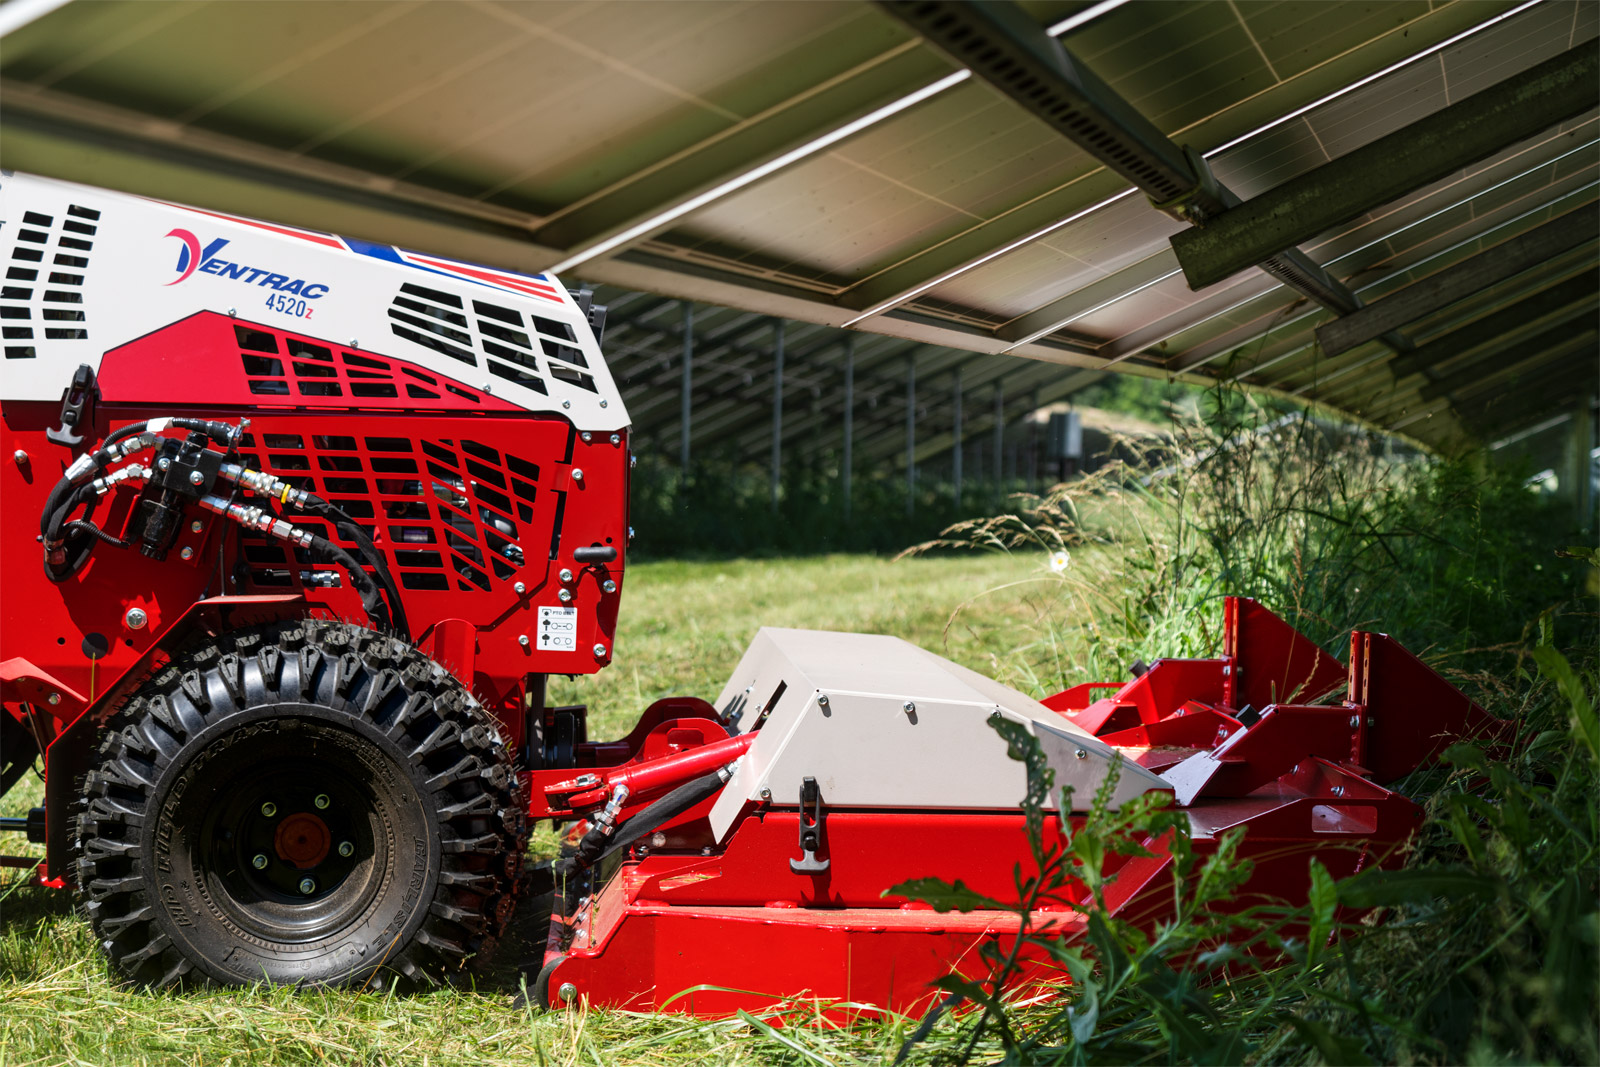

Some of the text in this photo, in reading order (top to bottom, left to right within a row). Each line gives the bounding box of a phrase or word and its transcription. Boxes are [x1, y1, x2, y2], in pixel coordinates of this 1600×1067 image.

[163, 228, 330, 299] VENTRAC
[157, 775, 188, 873] FIELD
[191, 719, 279, 771] TRAX
[372, 836, 427, 953] CARLISLE
